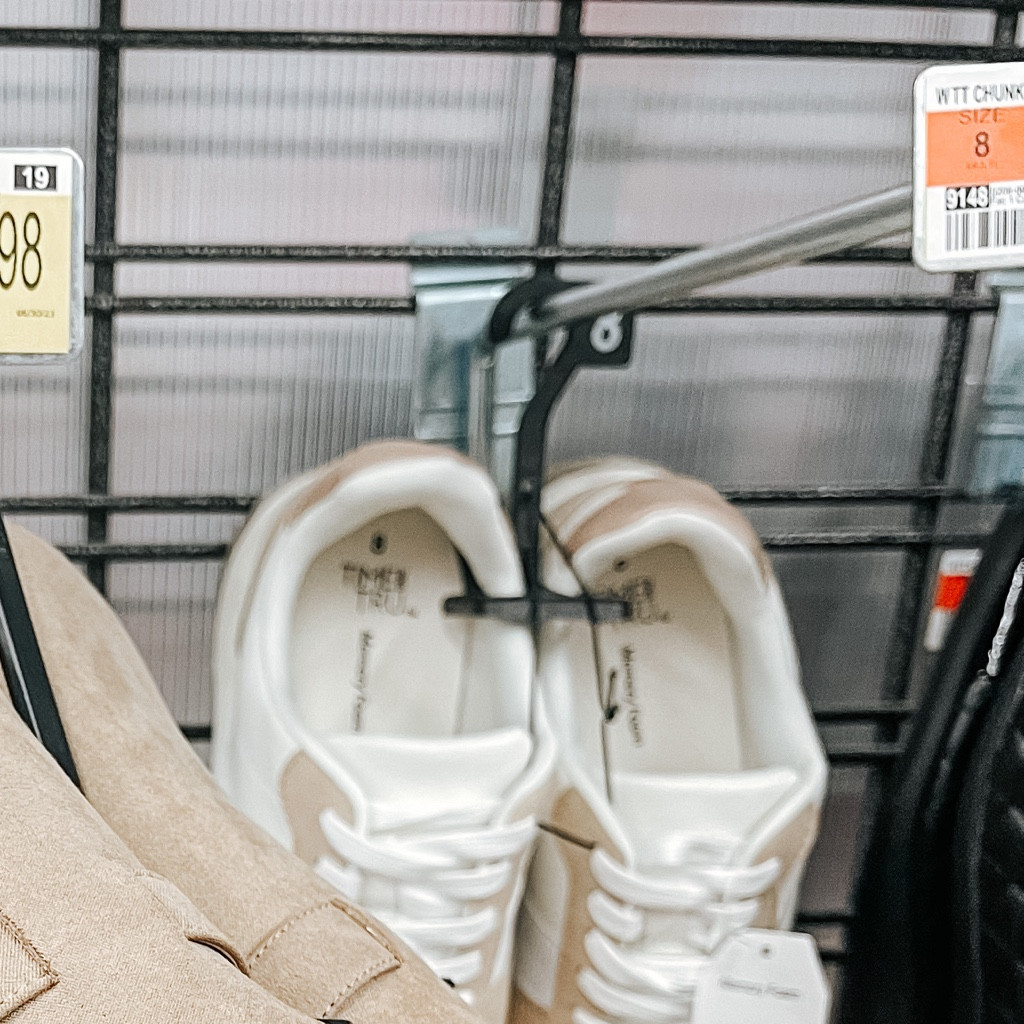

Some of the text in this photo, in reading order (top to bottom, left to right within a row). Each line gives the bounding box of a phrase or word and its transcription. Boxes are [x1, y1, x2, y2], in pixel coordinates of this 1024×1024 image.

[959, 108, 1005, 125] SIZE
[975, 131, 990, 158] 8
[22, 165, 51, 191] 19
[589, 311, 624, 354] 6
